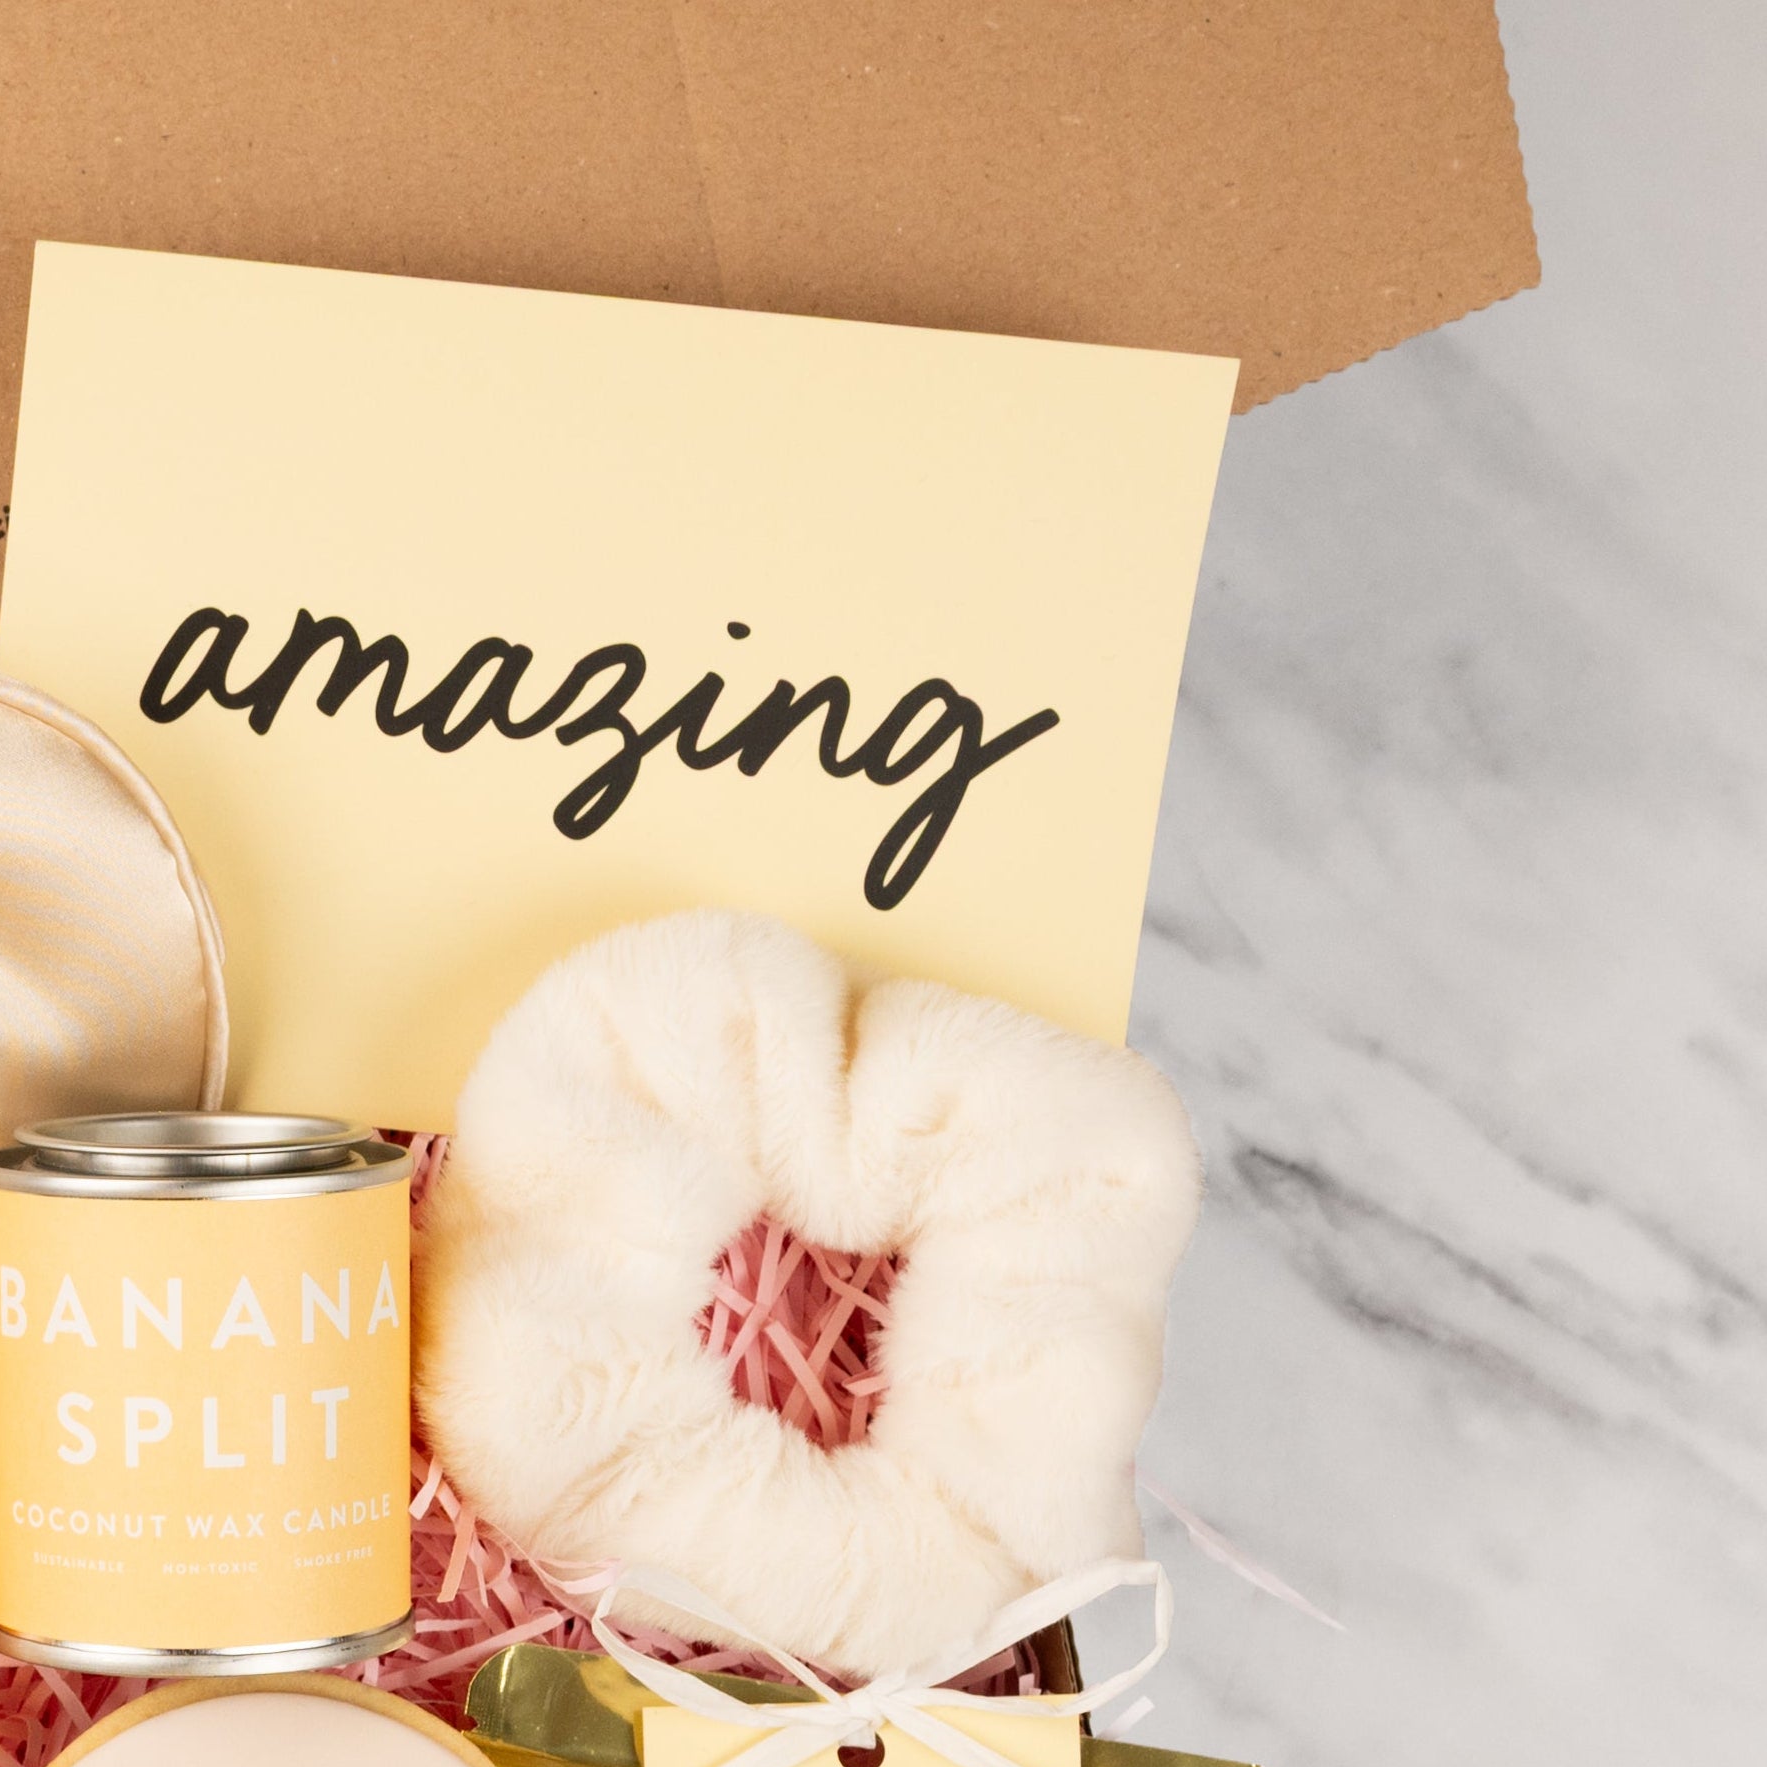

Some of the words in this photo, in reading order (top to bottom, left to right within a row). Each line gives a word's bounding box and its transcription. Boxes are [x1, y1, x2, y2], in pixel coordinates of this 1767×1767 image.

[139, 606, 1060, 911] amazing
[0, 1261, 400, 1351] BANANA
[57, 1386, 350, 1469] SPLIT
[12, 1500, 166, 1539] COCONUT
[186, 1513, 266, 1539] WAX
[283, 1494, 391, 1536] CANDLE
[33, 1551, 125, 1575] SUSTAINABLE
[162, 1561, 259, 1575] NON-TOXIC
[294, 1552, 341, 1569] SMOKE
